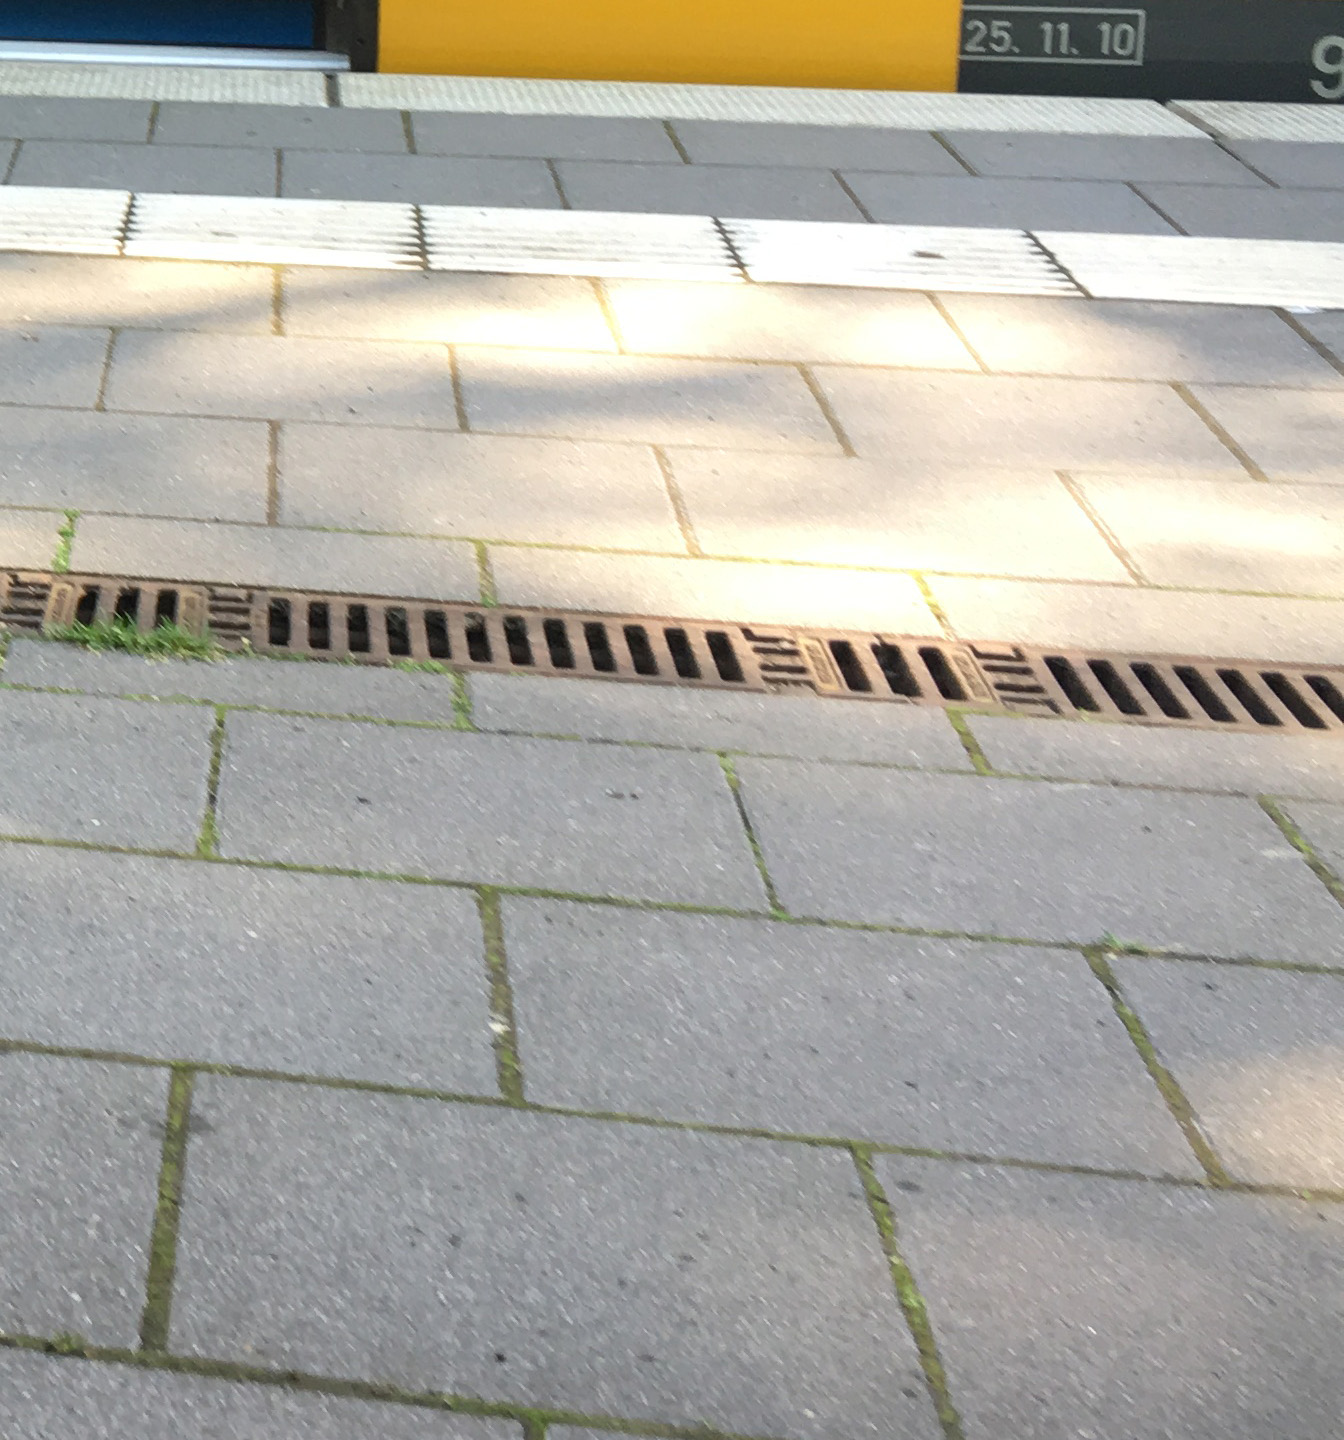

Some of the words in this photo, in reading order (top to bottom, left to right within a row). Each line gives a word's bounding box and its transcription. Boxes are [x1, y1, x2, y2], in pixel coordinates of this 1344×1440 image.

[964, 19, 1020, 54] 25.
[1040, 21, 1080, 56] 11.
[1097, 21, 1136, 56] 10
